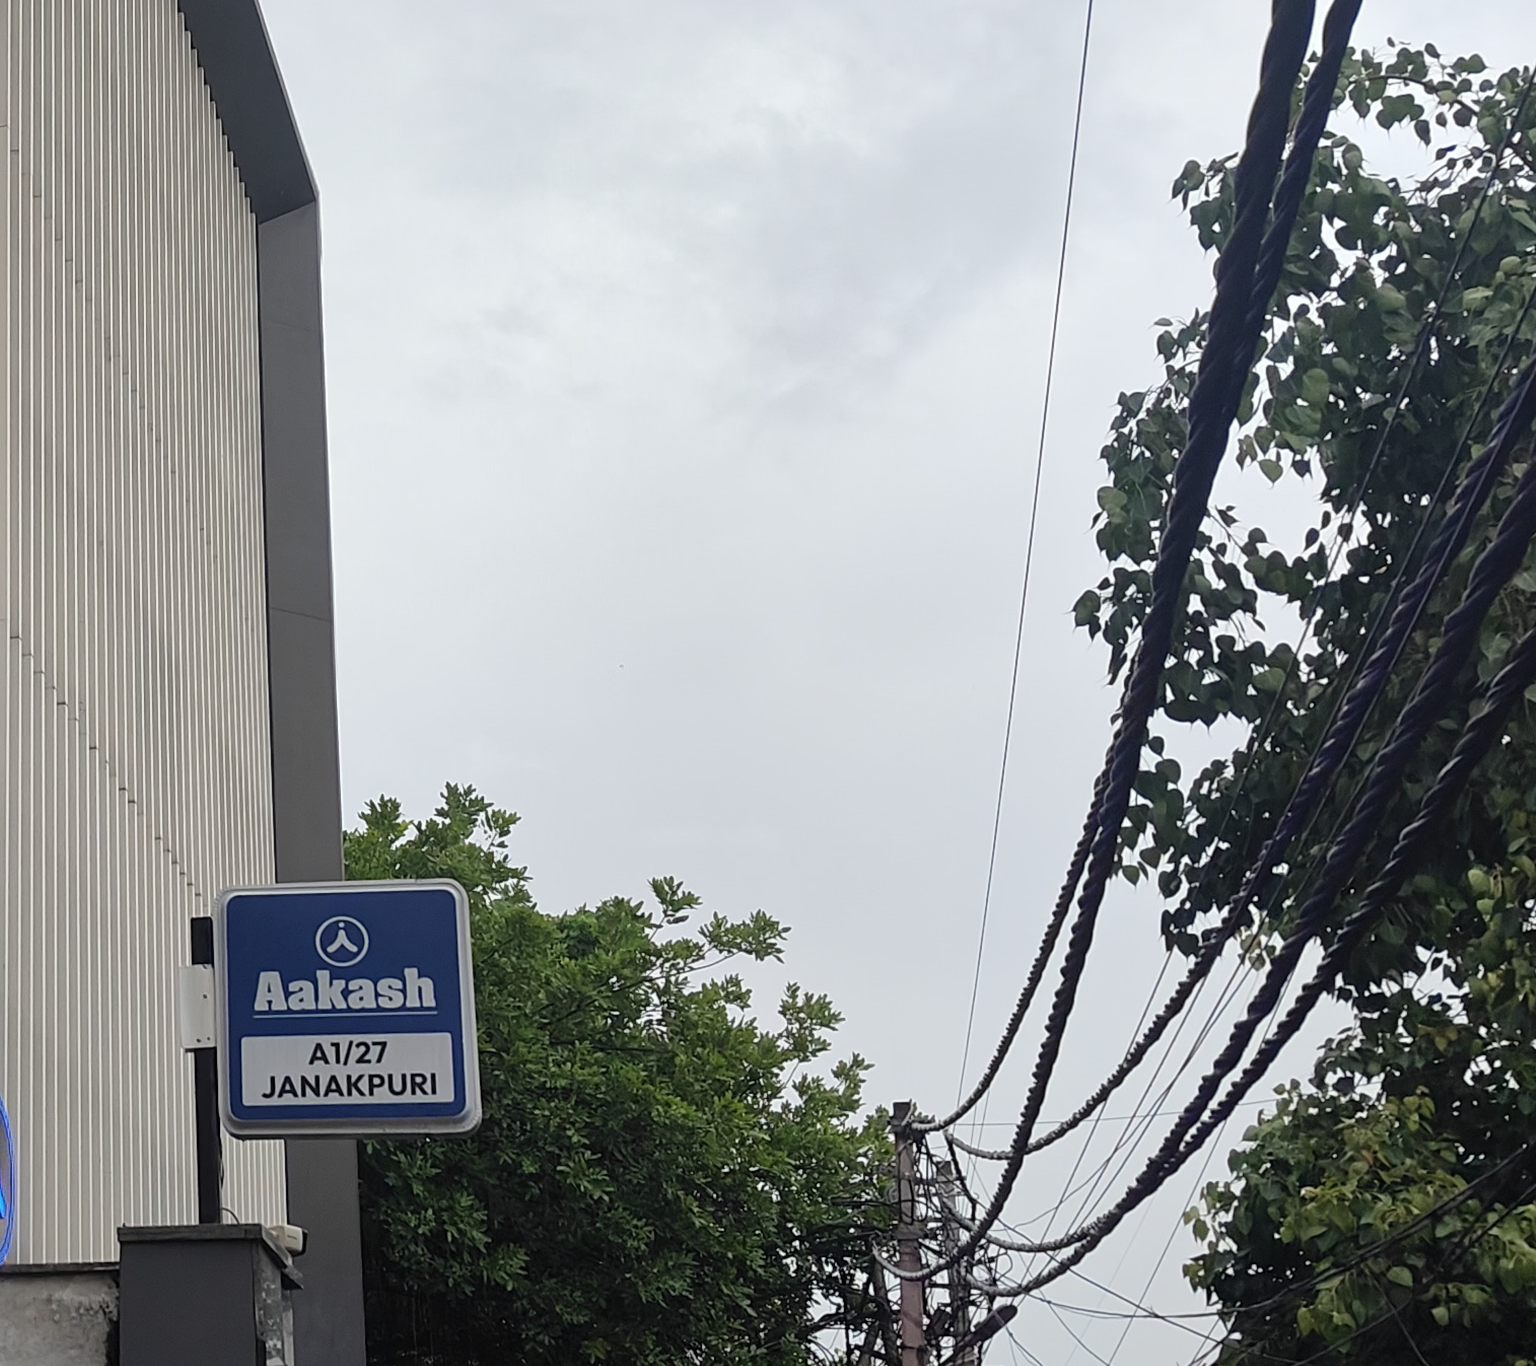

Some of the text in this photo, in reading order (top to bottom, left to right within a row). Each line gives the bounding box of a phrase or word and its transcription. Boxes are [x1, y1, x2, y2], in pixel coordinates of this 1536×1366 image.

[253, 967, 437, 1013] Aakash
[308, 1040, 388, 1067] A1/27
[260, 1072, 439, 1100] JANAKPURI
